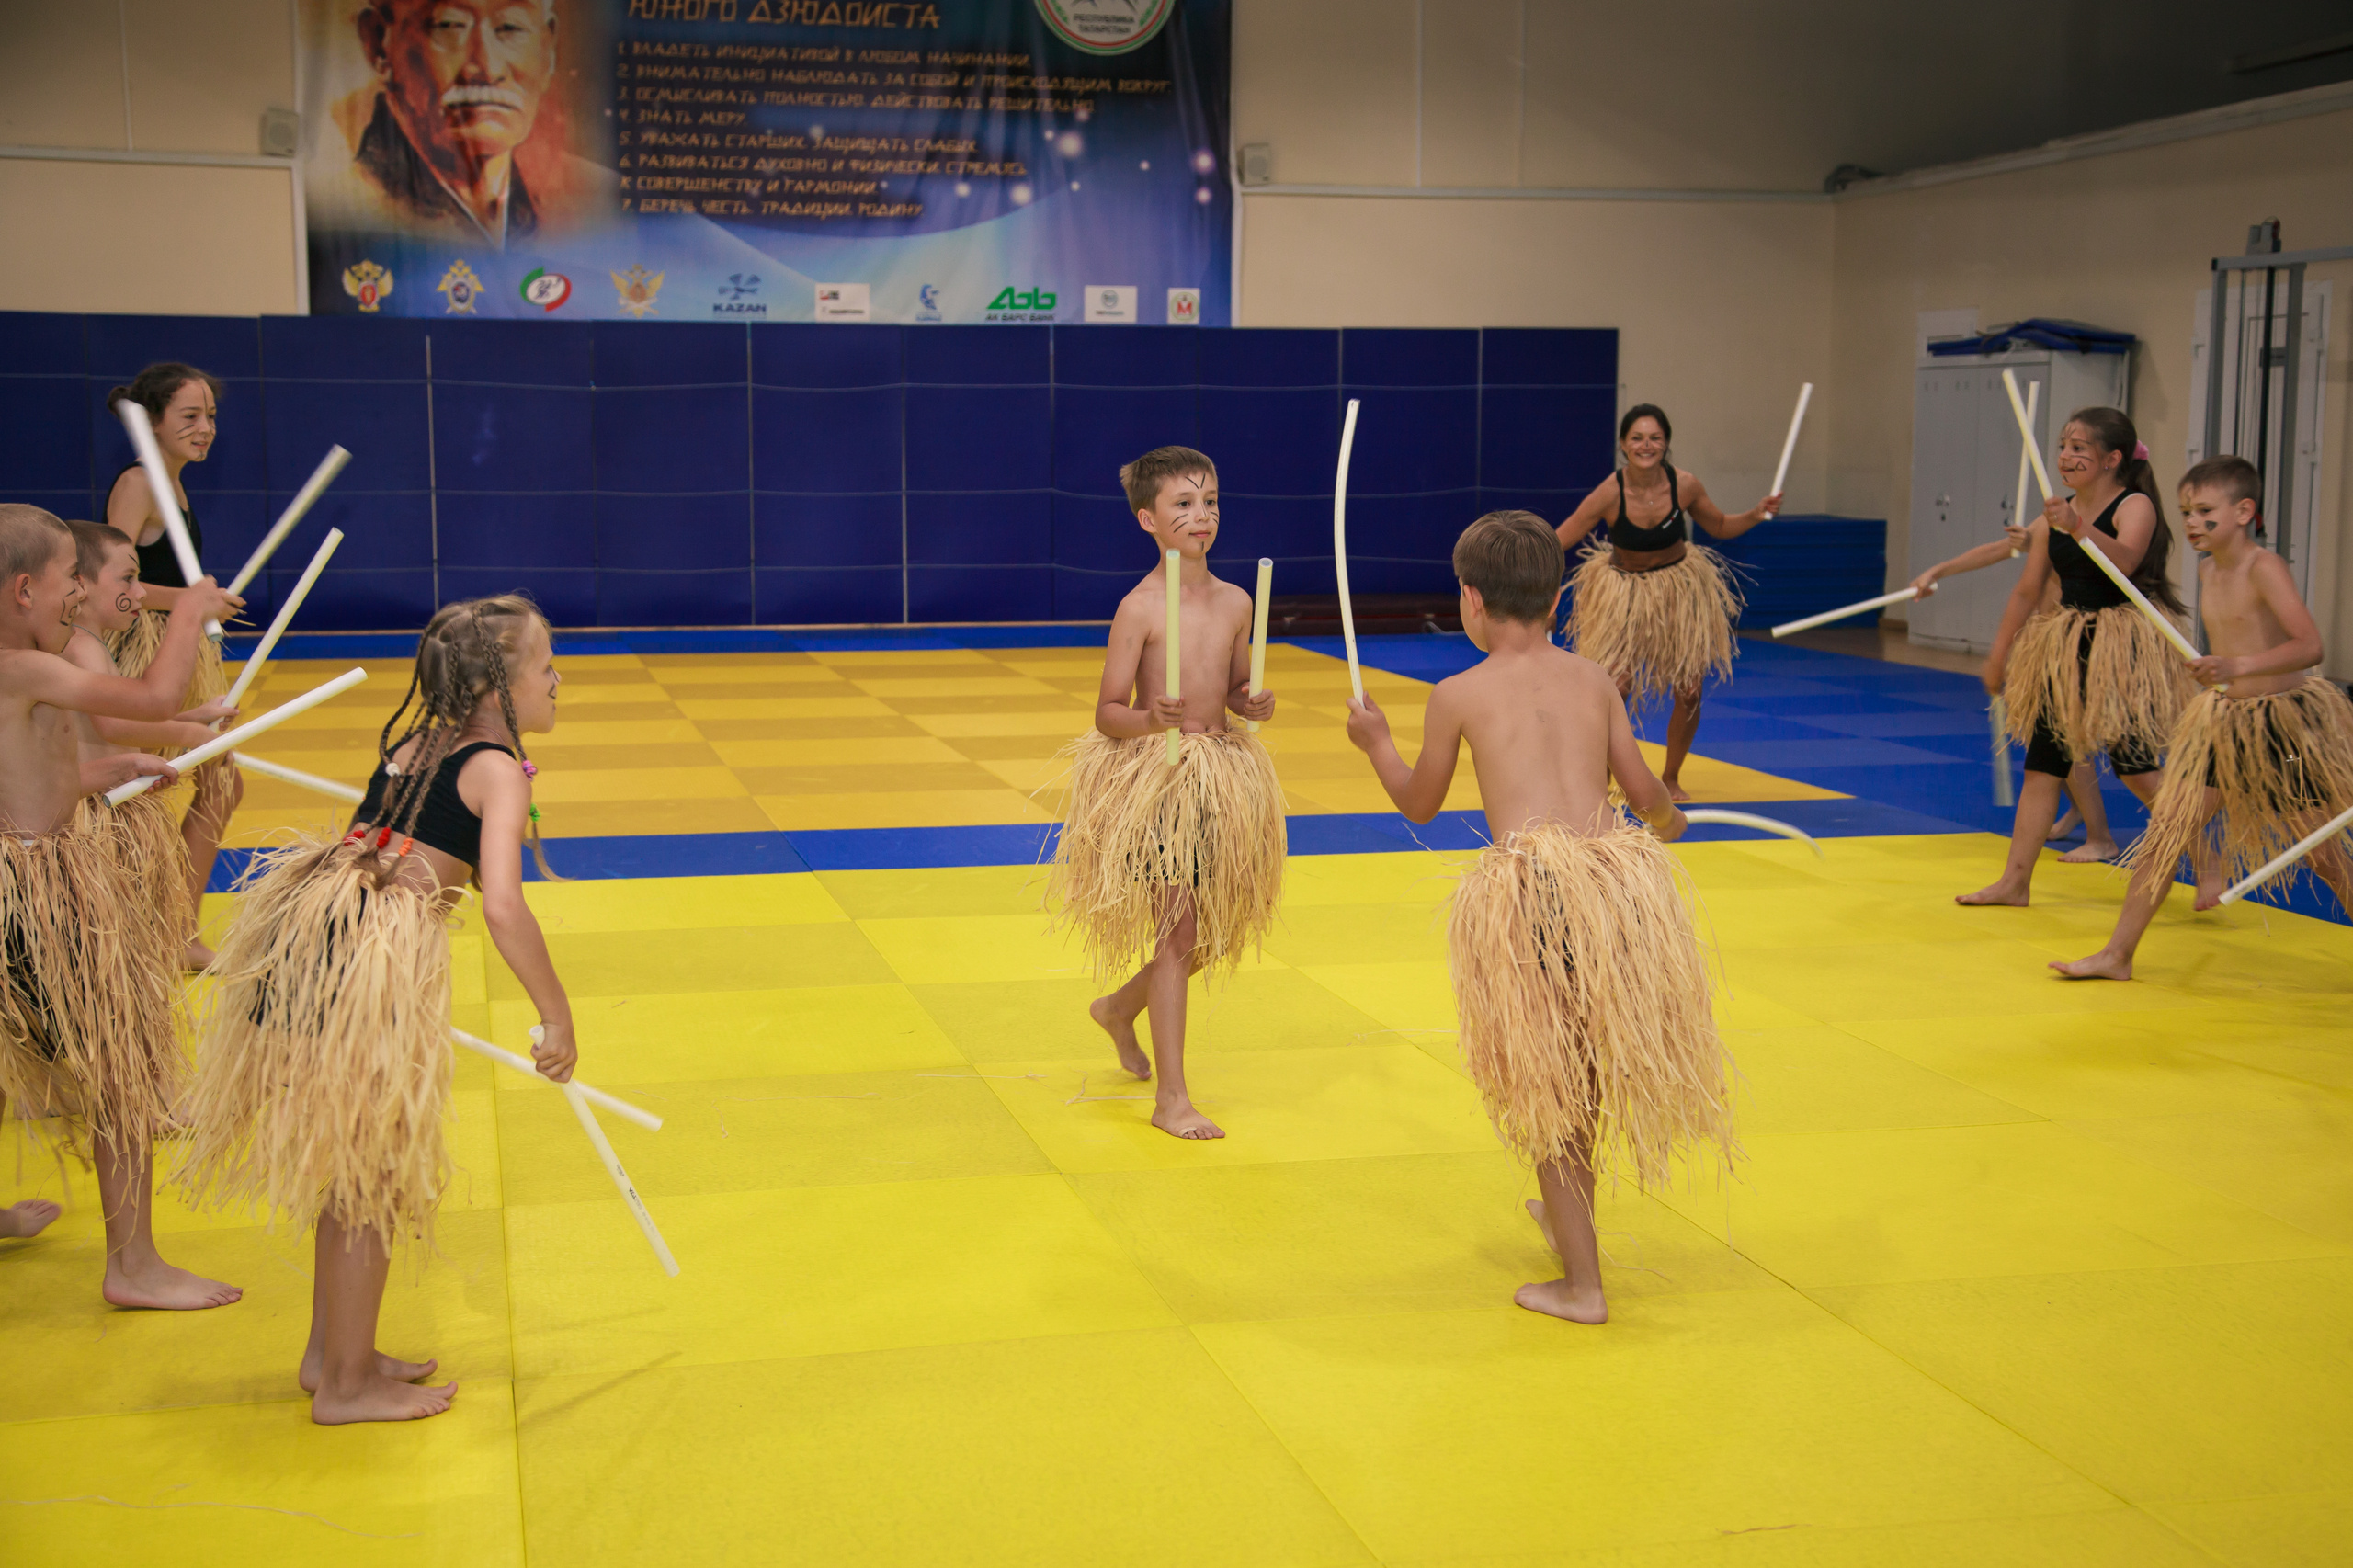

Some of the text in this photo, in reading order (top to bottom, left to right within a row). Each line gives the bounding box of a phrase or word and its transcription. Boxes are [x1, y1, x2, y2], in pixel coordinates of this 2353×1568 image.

[628, 0, 941, 29] ЮНОГО ДЗЮДОИСТА
[632, 41, 710, 58] ВЛАДЕТЬ
[716, 44, 840, 64] ИНИЦИАТИВОЙ
[858, 49, 921, 64] ЛЮБОМ
[636, 64, 767, 83] ВНИМАТЕЛЬНО
[771, 68, 879, 85] НАБЛЮДАТЬ
[883, 73, 905, 86] ЗА
[909, 70, 960, 87] СОБОЙ
[963, 74, 976, 87] И
[981, 74, 1113, 96] ПРОИСХОДЯЩИМ
[635, 86, 758, 104] ОСМЫСЛИВАТЬ
[871, 91, 983, 109] ДЕЙСТВОВАТЬ
[636, 108, 693, 125] ЗНАТЬ
[640, 131, 721, 148] УВАЖАТЬ
[813, 137, 910, 155] ЗАЩИЩАТЬ
[639, 154, 750, 171] РАЗВИВАТЬСЯ
[753, 157, 828, 172] ДУХОВНО
[831, 159, 845, 173] И
[946, 161, 1029, 176] СТРЕМЯСЬ
[636, 176, 763, 194] СОВЕРШЕНСТВУ
[766, 179, 780, 193] И
[639, 199, 698, 214] БЕРЕЧЬ
[712, 303, 767, 312] KAZAN
